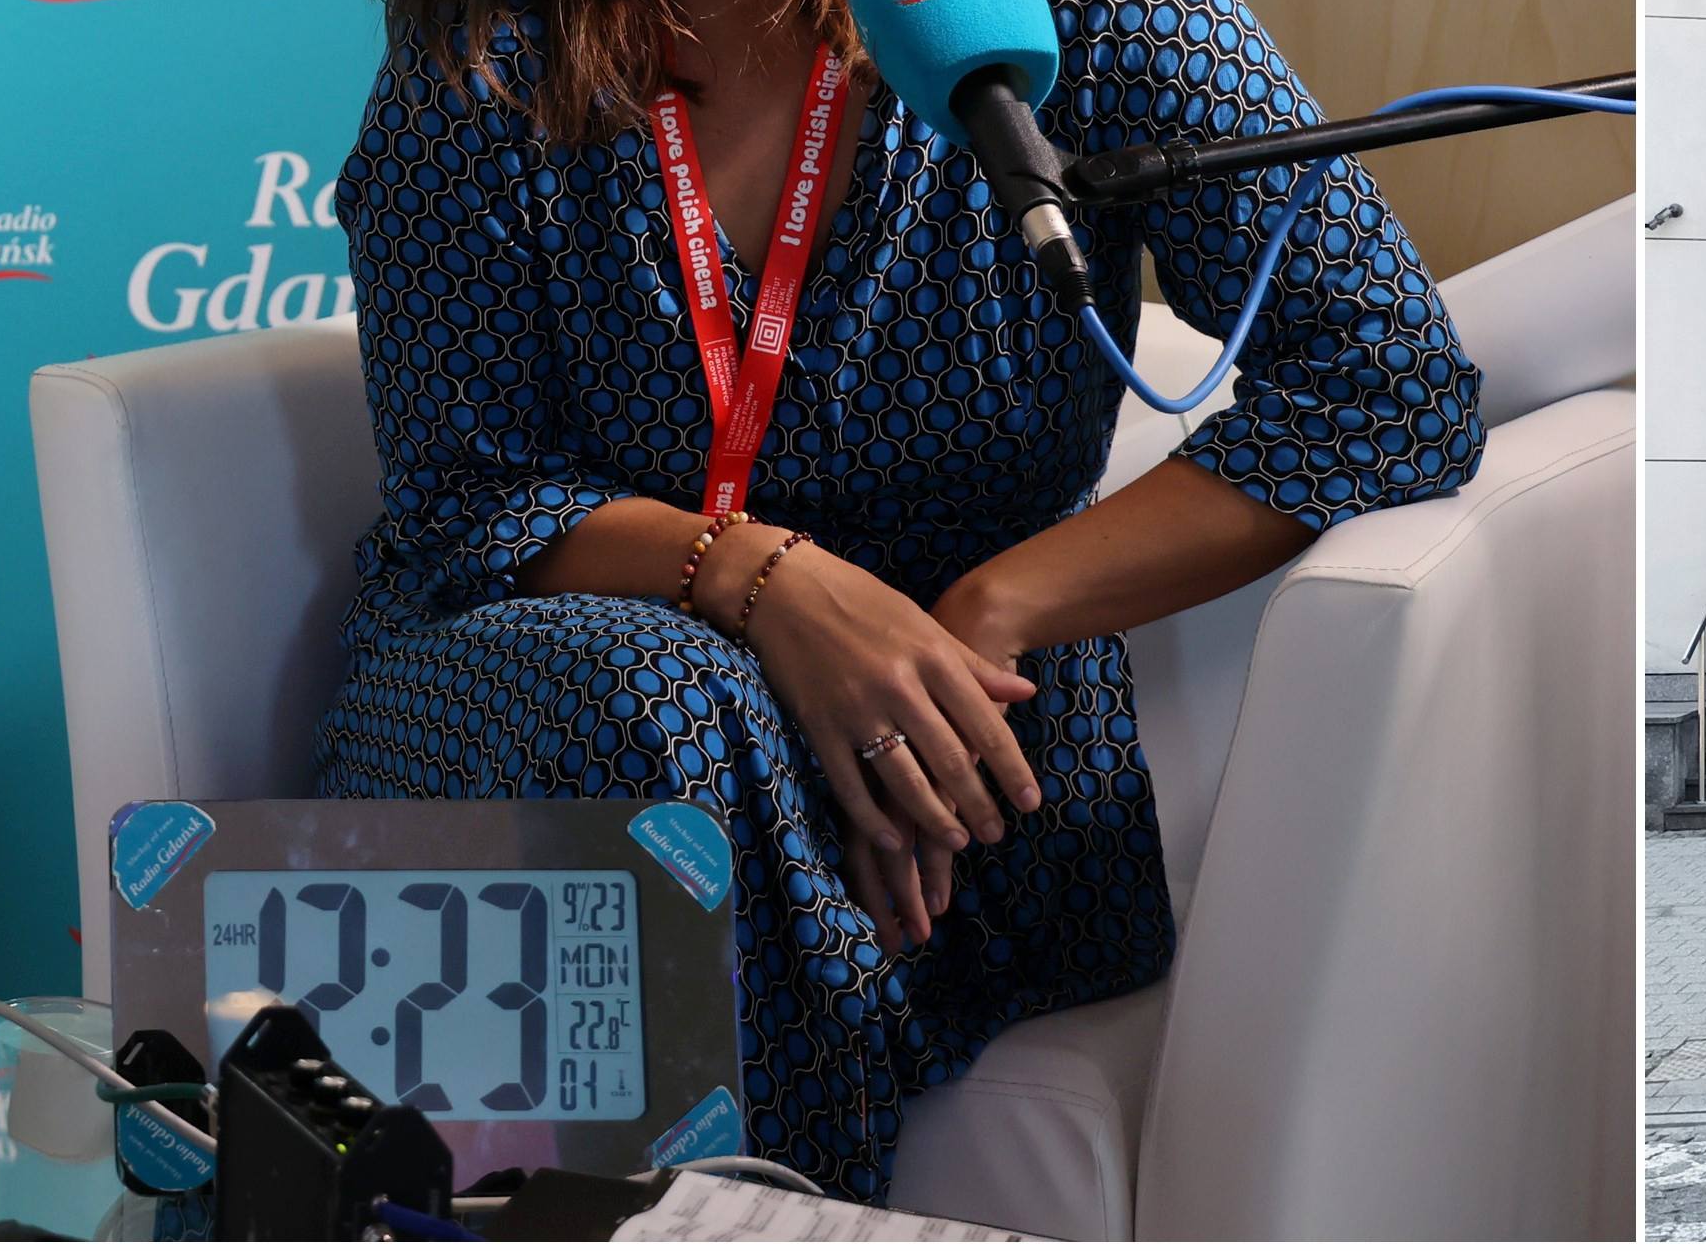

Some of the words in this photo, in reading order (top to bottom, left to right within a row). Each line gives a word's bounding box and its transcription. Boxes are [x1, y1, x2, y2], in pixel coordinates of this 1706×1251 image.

[816, 51, 843, 101] cine
[659, 105, 683, 161] love
[800, 104, 832, 176] polish
[669, 164, 705, 235] polish
[785, 179, 814, 232] love
[780, 235, 801, 246] I
[688, 237, 717, 310] cinema
[713, 347, 730, 407] FABULARNYCH
[129, 863, 161, 897] Radio
[157, 816, 204, 864] Gdańsk
[640, 820, 673, 852] Radio
[672, 849, 719, 896] Gdańsk
[212, 923, 257, 946] 24HR
[560, 943, 629, 988] MON
[175, 1142, 211, 1175] Radio
